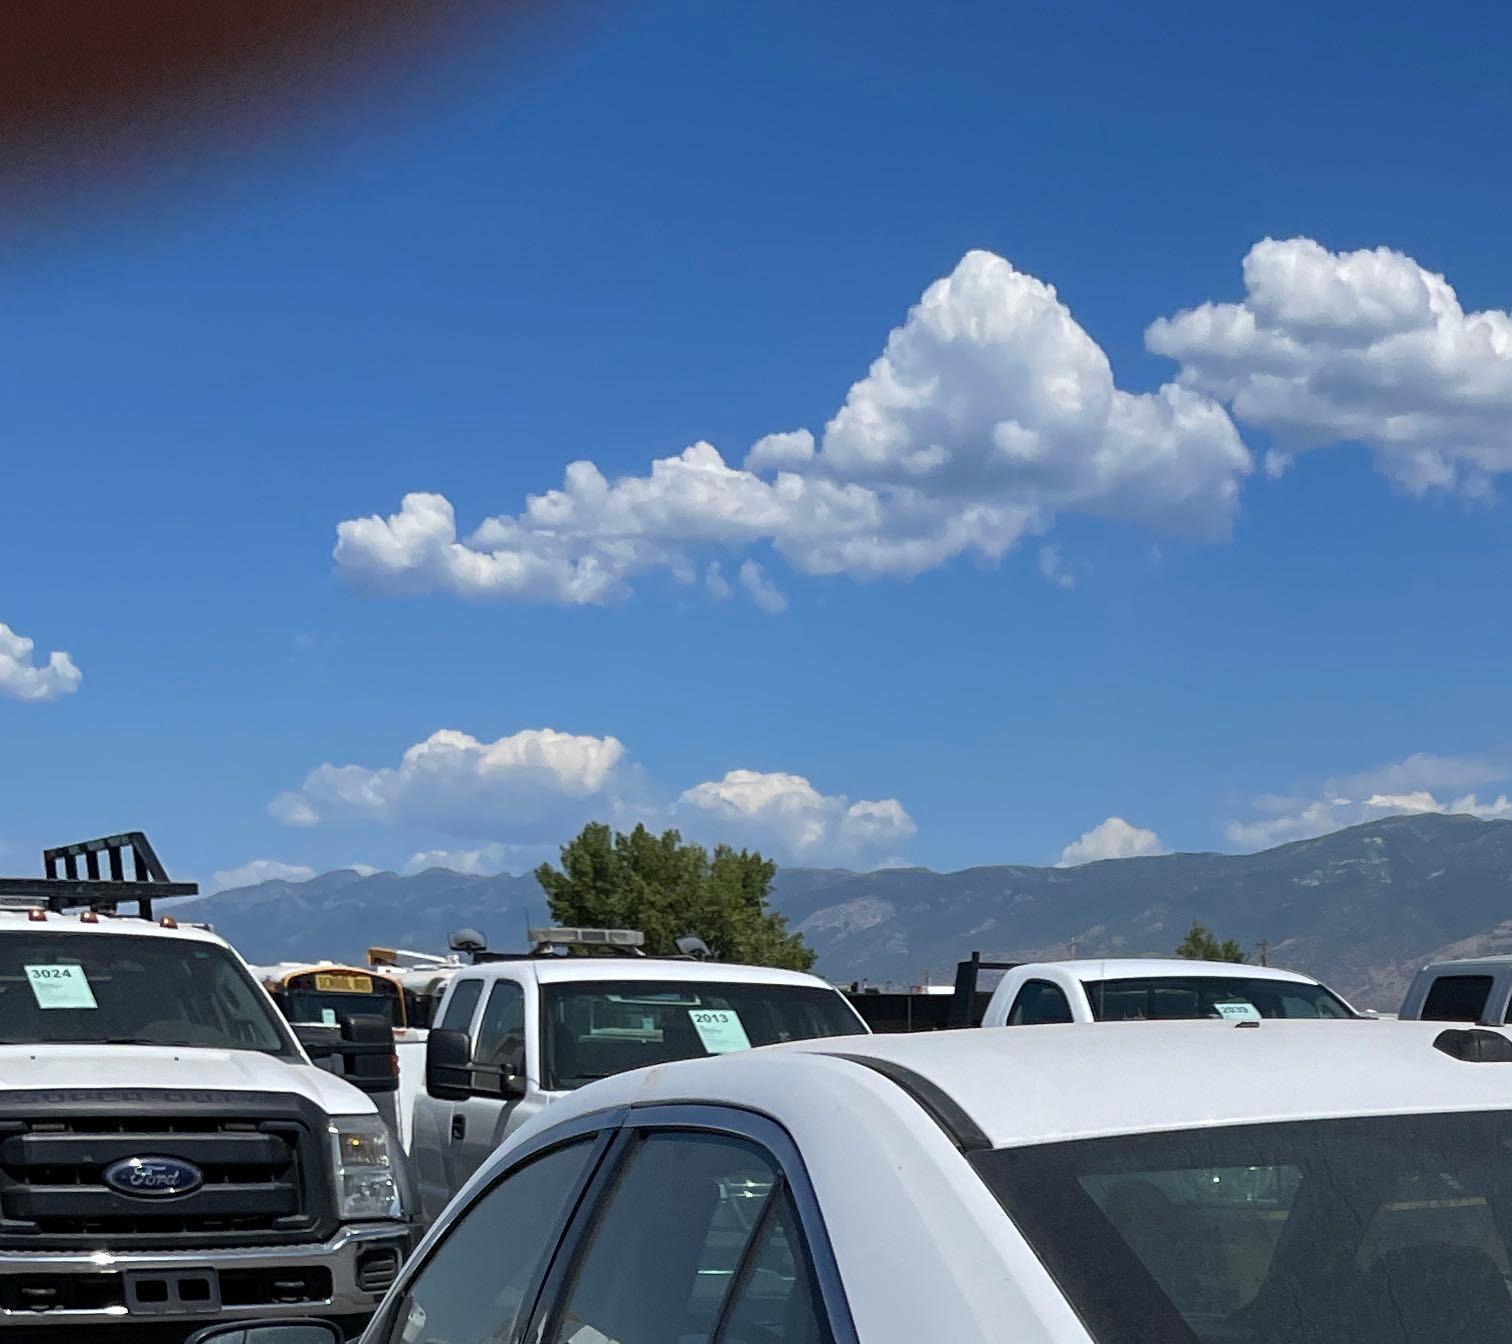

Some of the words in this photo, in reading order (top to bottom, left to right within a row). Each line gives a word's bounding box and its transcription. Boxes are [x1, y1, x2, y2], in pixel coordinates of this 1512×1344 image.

[31, 969, 72, 979] 3024
[694, 1013, 729, 1023] 2013
[129, 1165, 181, 1187] Ford
